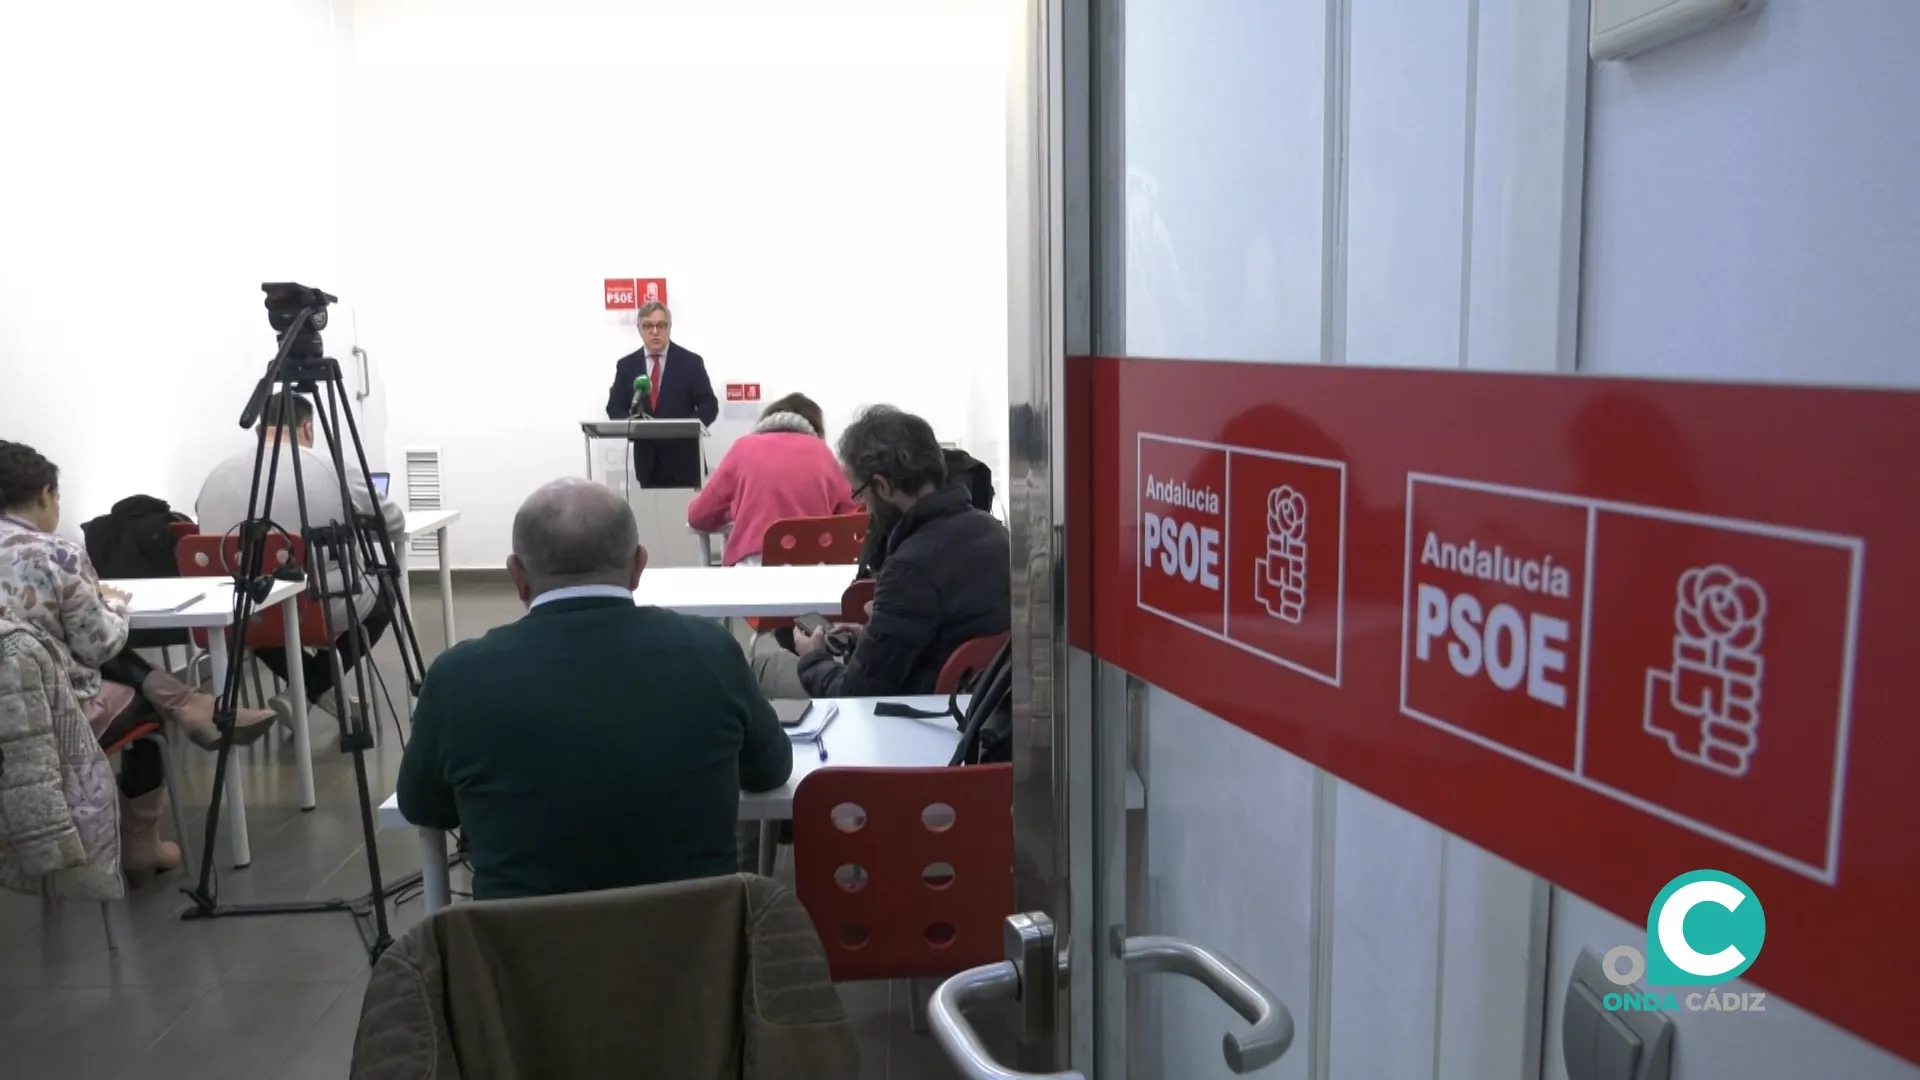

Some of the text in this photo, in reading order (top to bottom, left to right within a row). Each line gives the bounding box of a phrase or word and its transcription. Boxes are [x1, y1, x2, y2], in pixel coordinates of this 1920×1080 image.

[606, 292, 633, 304] PSOE
[1145, 474, 1220, 515] Andalucía
[1143, 512, 1220, 591] PSOE
[1420, 531, 1570, 598] Andalucía
[1416, 582, 1570, 709] PSOE
